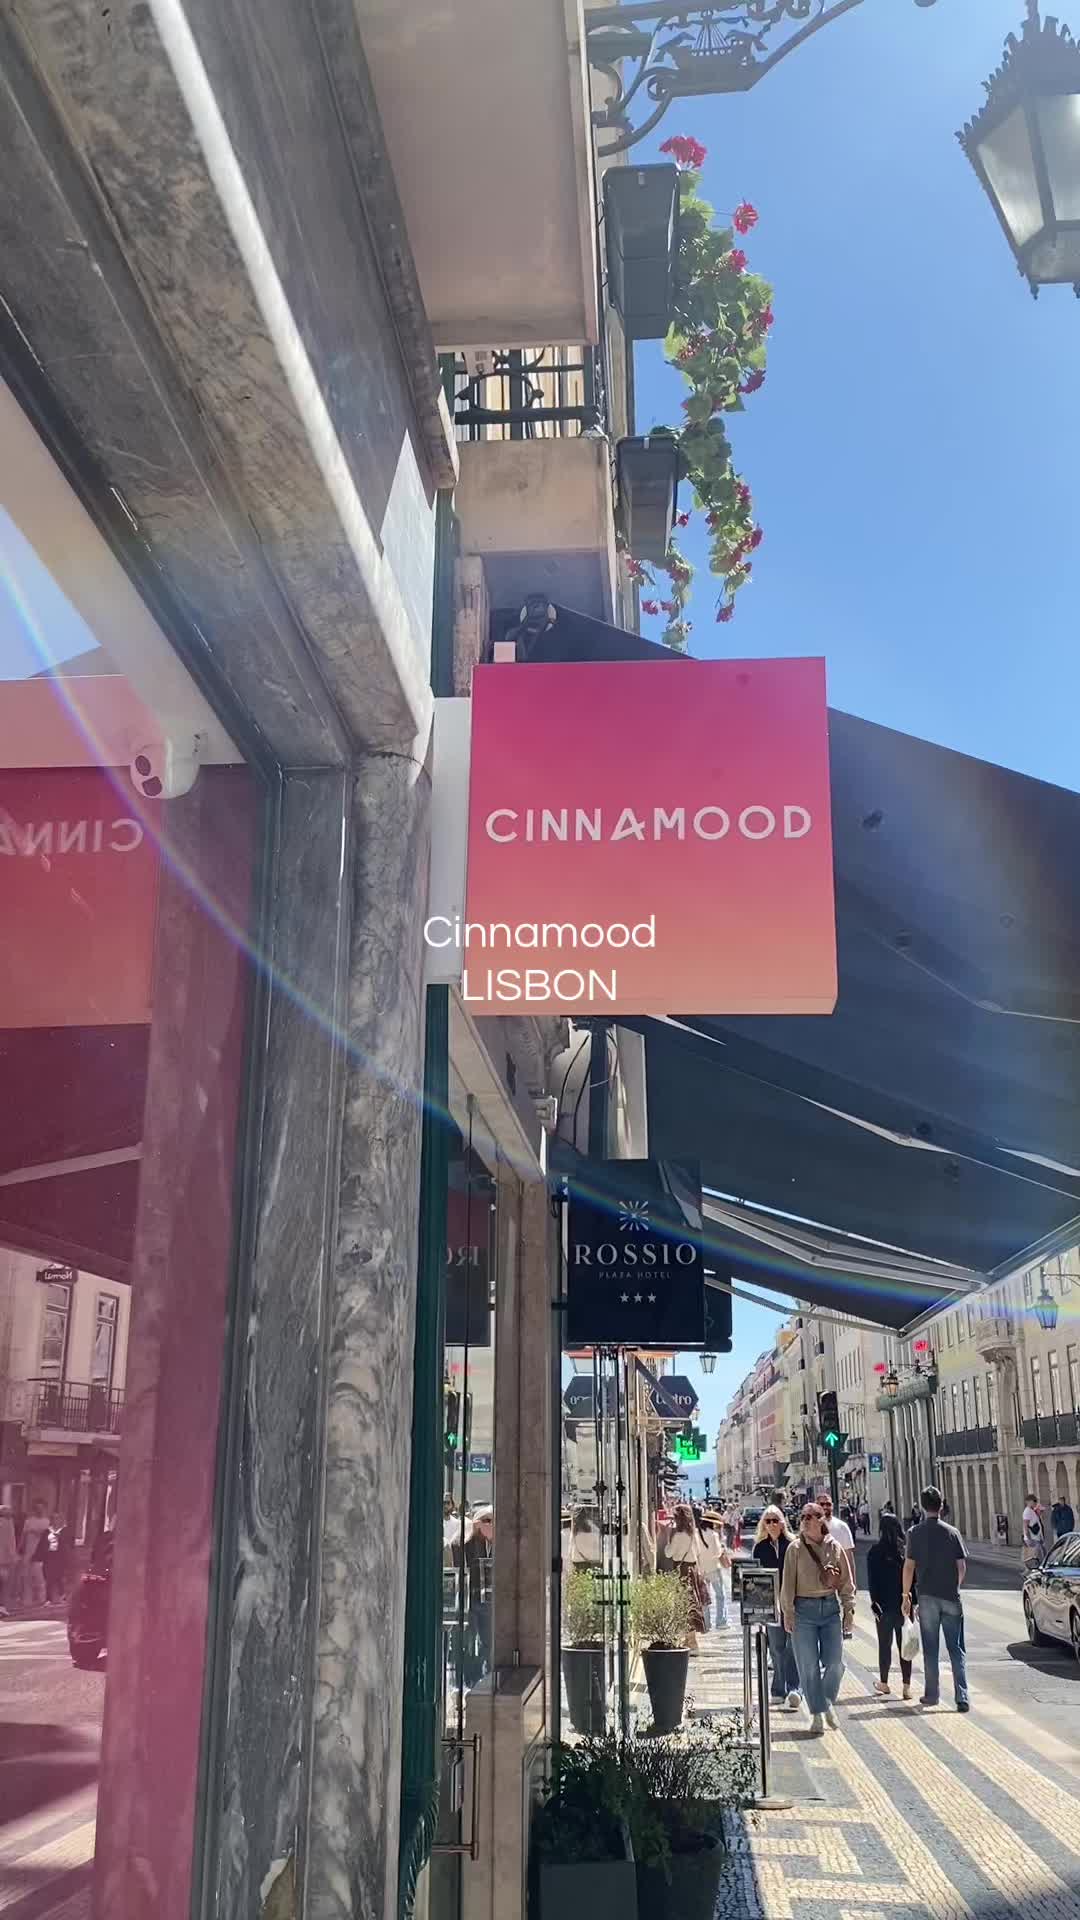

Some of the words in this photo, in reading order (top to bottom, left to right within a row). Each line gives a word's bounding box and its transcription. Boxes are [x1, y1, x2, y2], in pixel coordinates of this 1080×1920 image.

[485, 805, 812, 842] CINNAMOOD
[574, 1243, 697, 1265] ROSSIO
[599, 1271, 632, 1279] PLAZA
[637, 1271, 672, 1279] HOTEL
